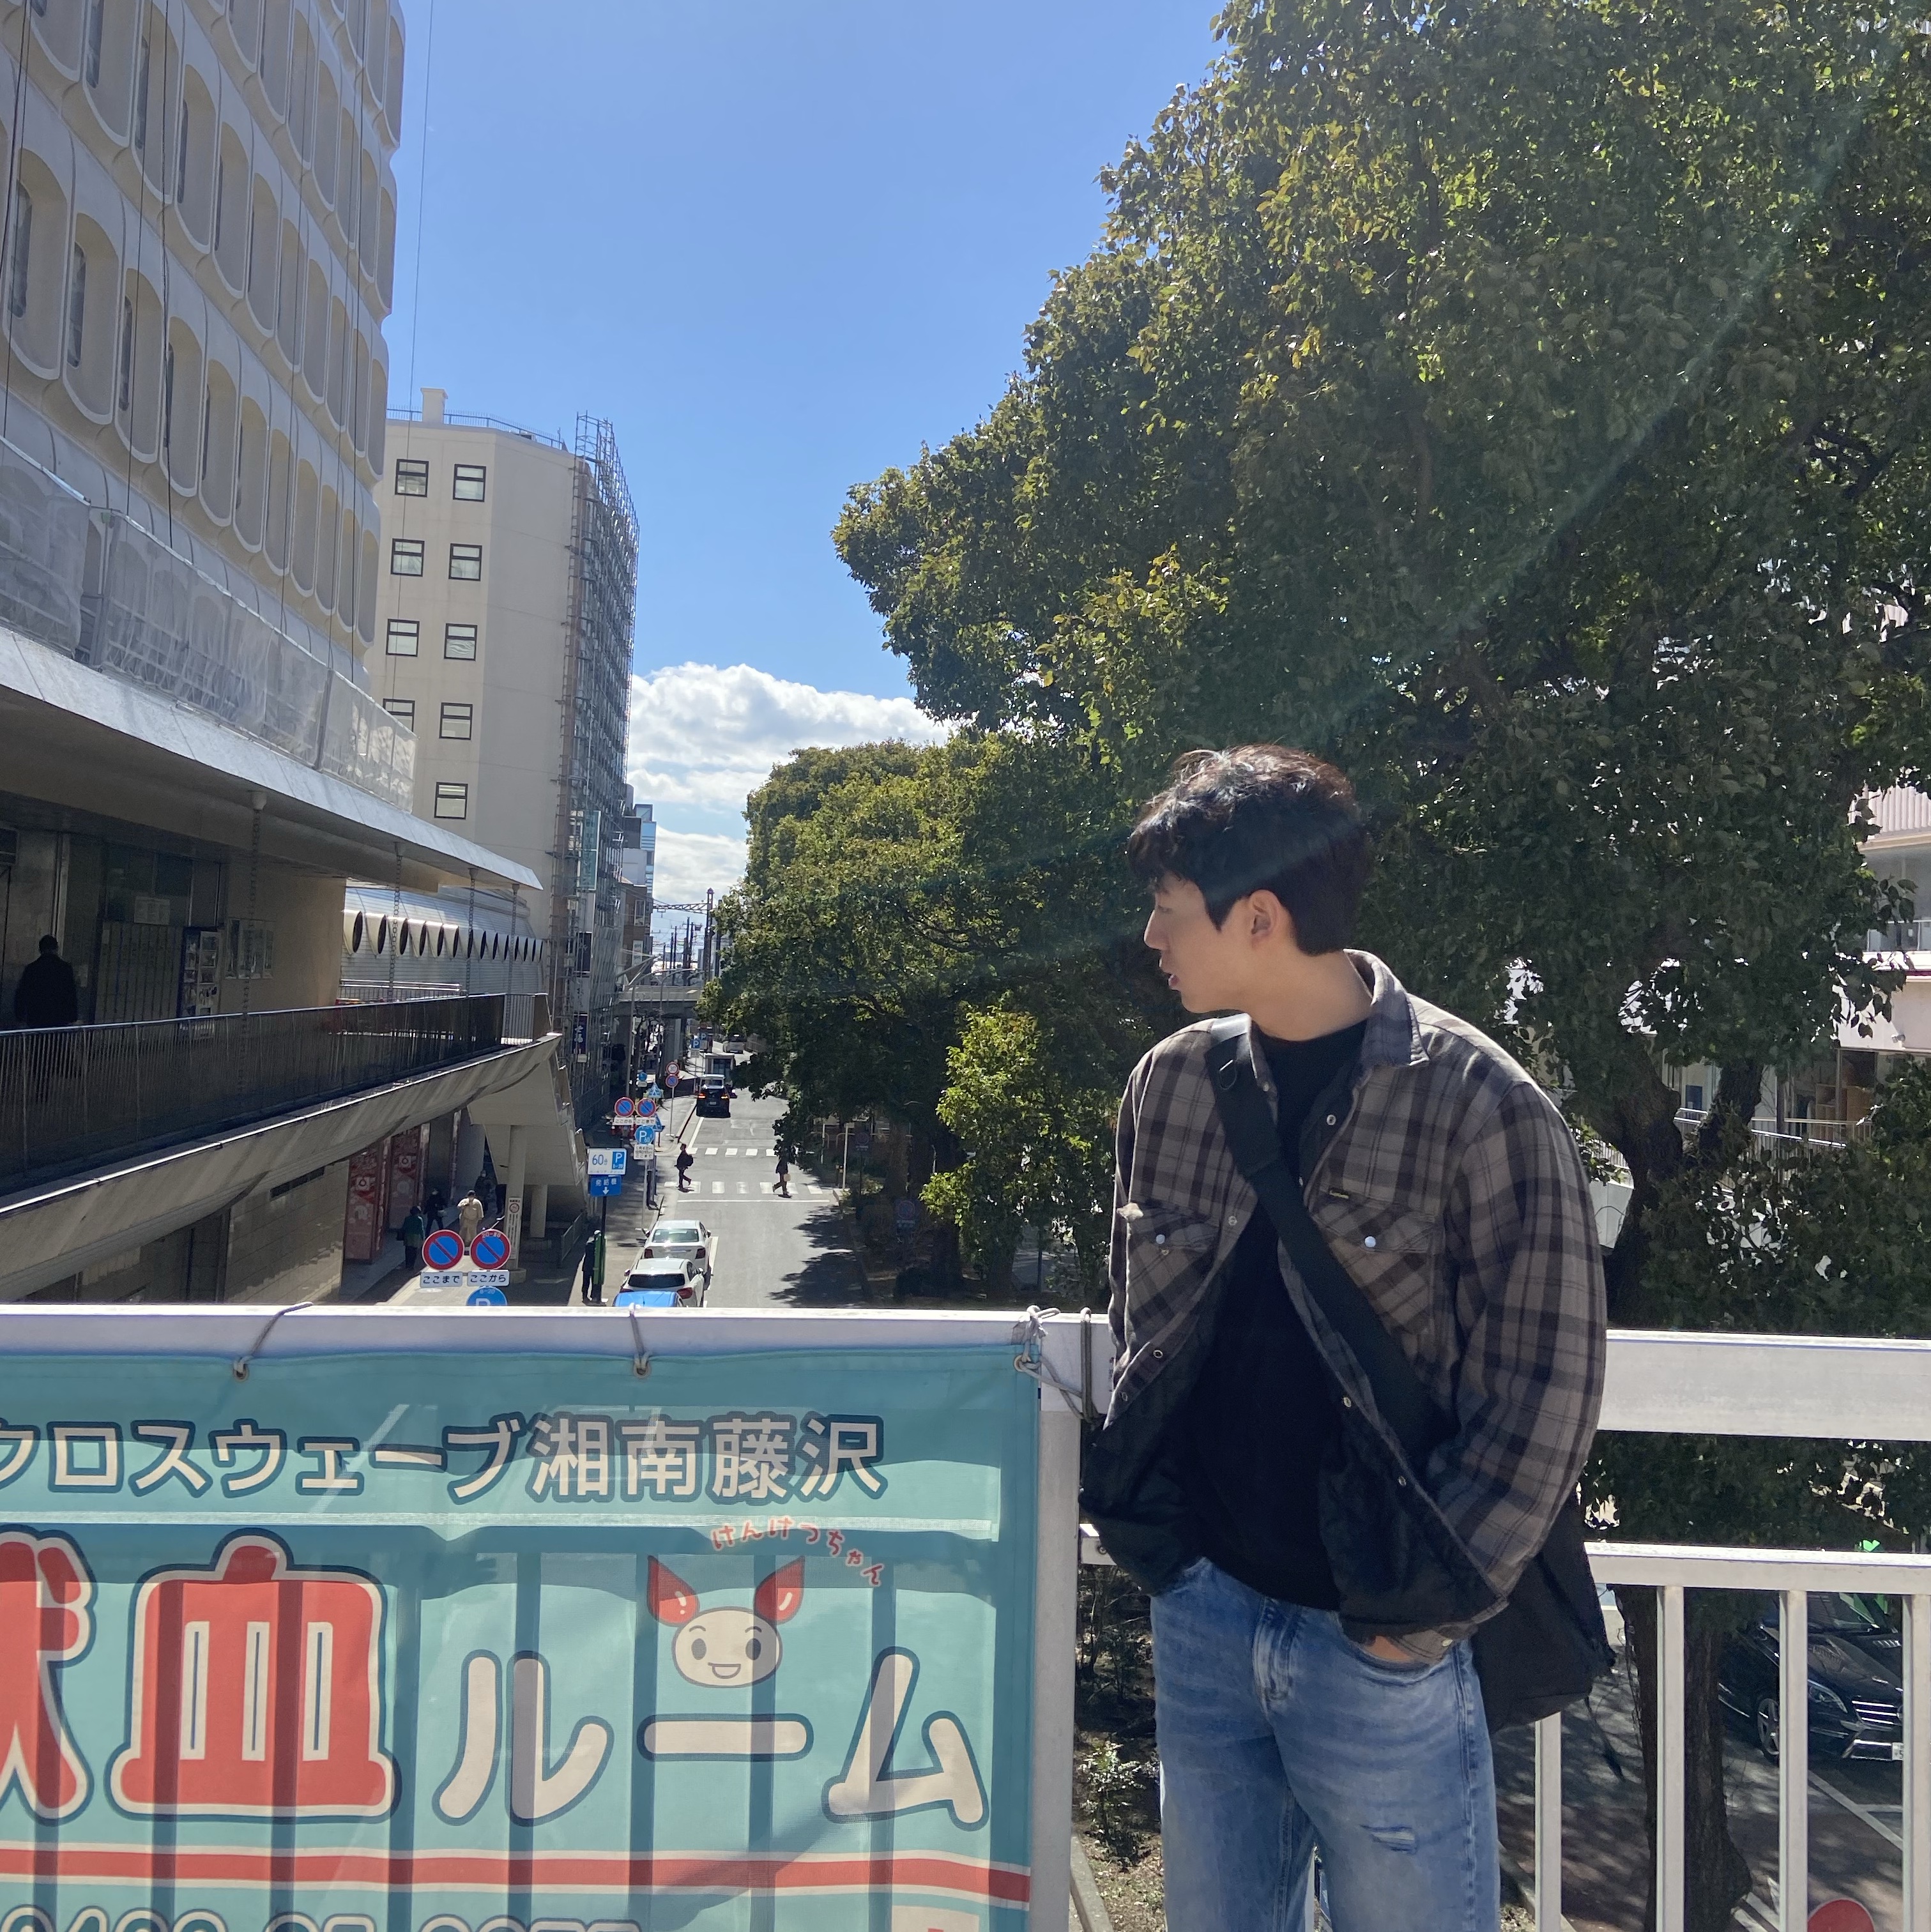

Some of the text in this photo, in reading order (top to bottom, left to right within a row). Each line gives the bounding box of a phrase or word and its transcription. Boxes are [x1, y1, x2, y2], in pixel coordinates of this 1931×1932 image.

[639, 1130, 646, 1143] P
[615, 1152, 622, 1163] P
[423, 1275, 460, 1284] ここまで
[470, 1274, 506, 1283] ここから
